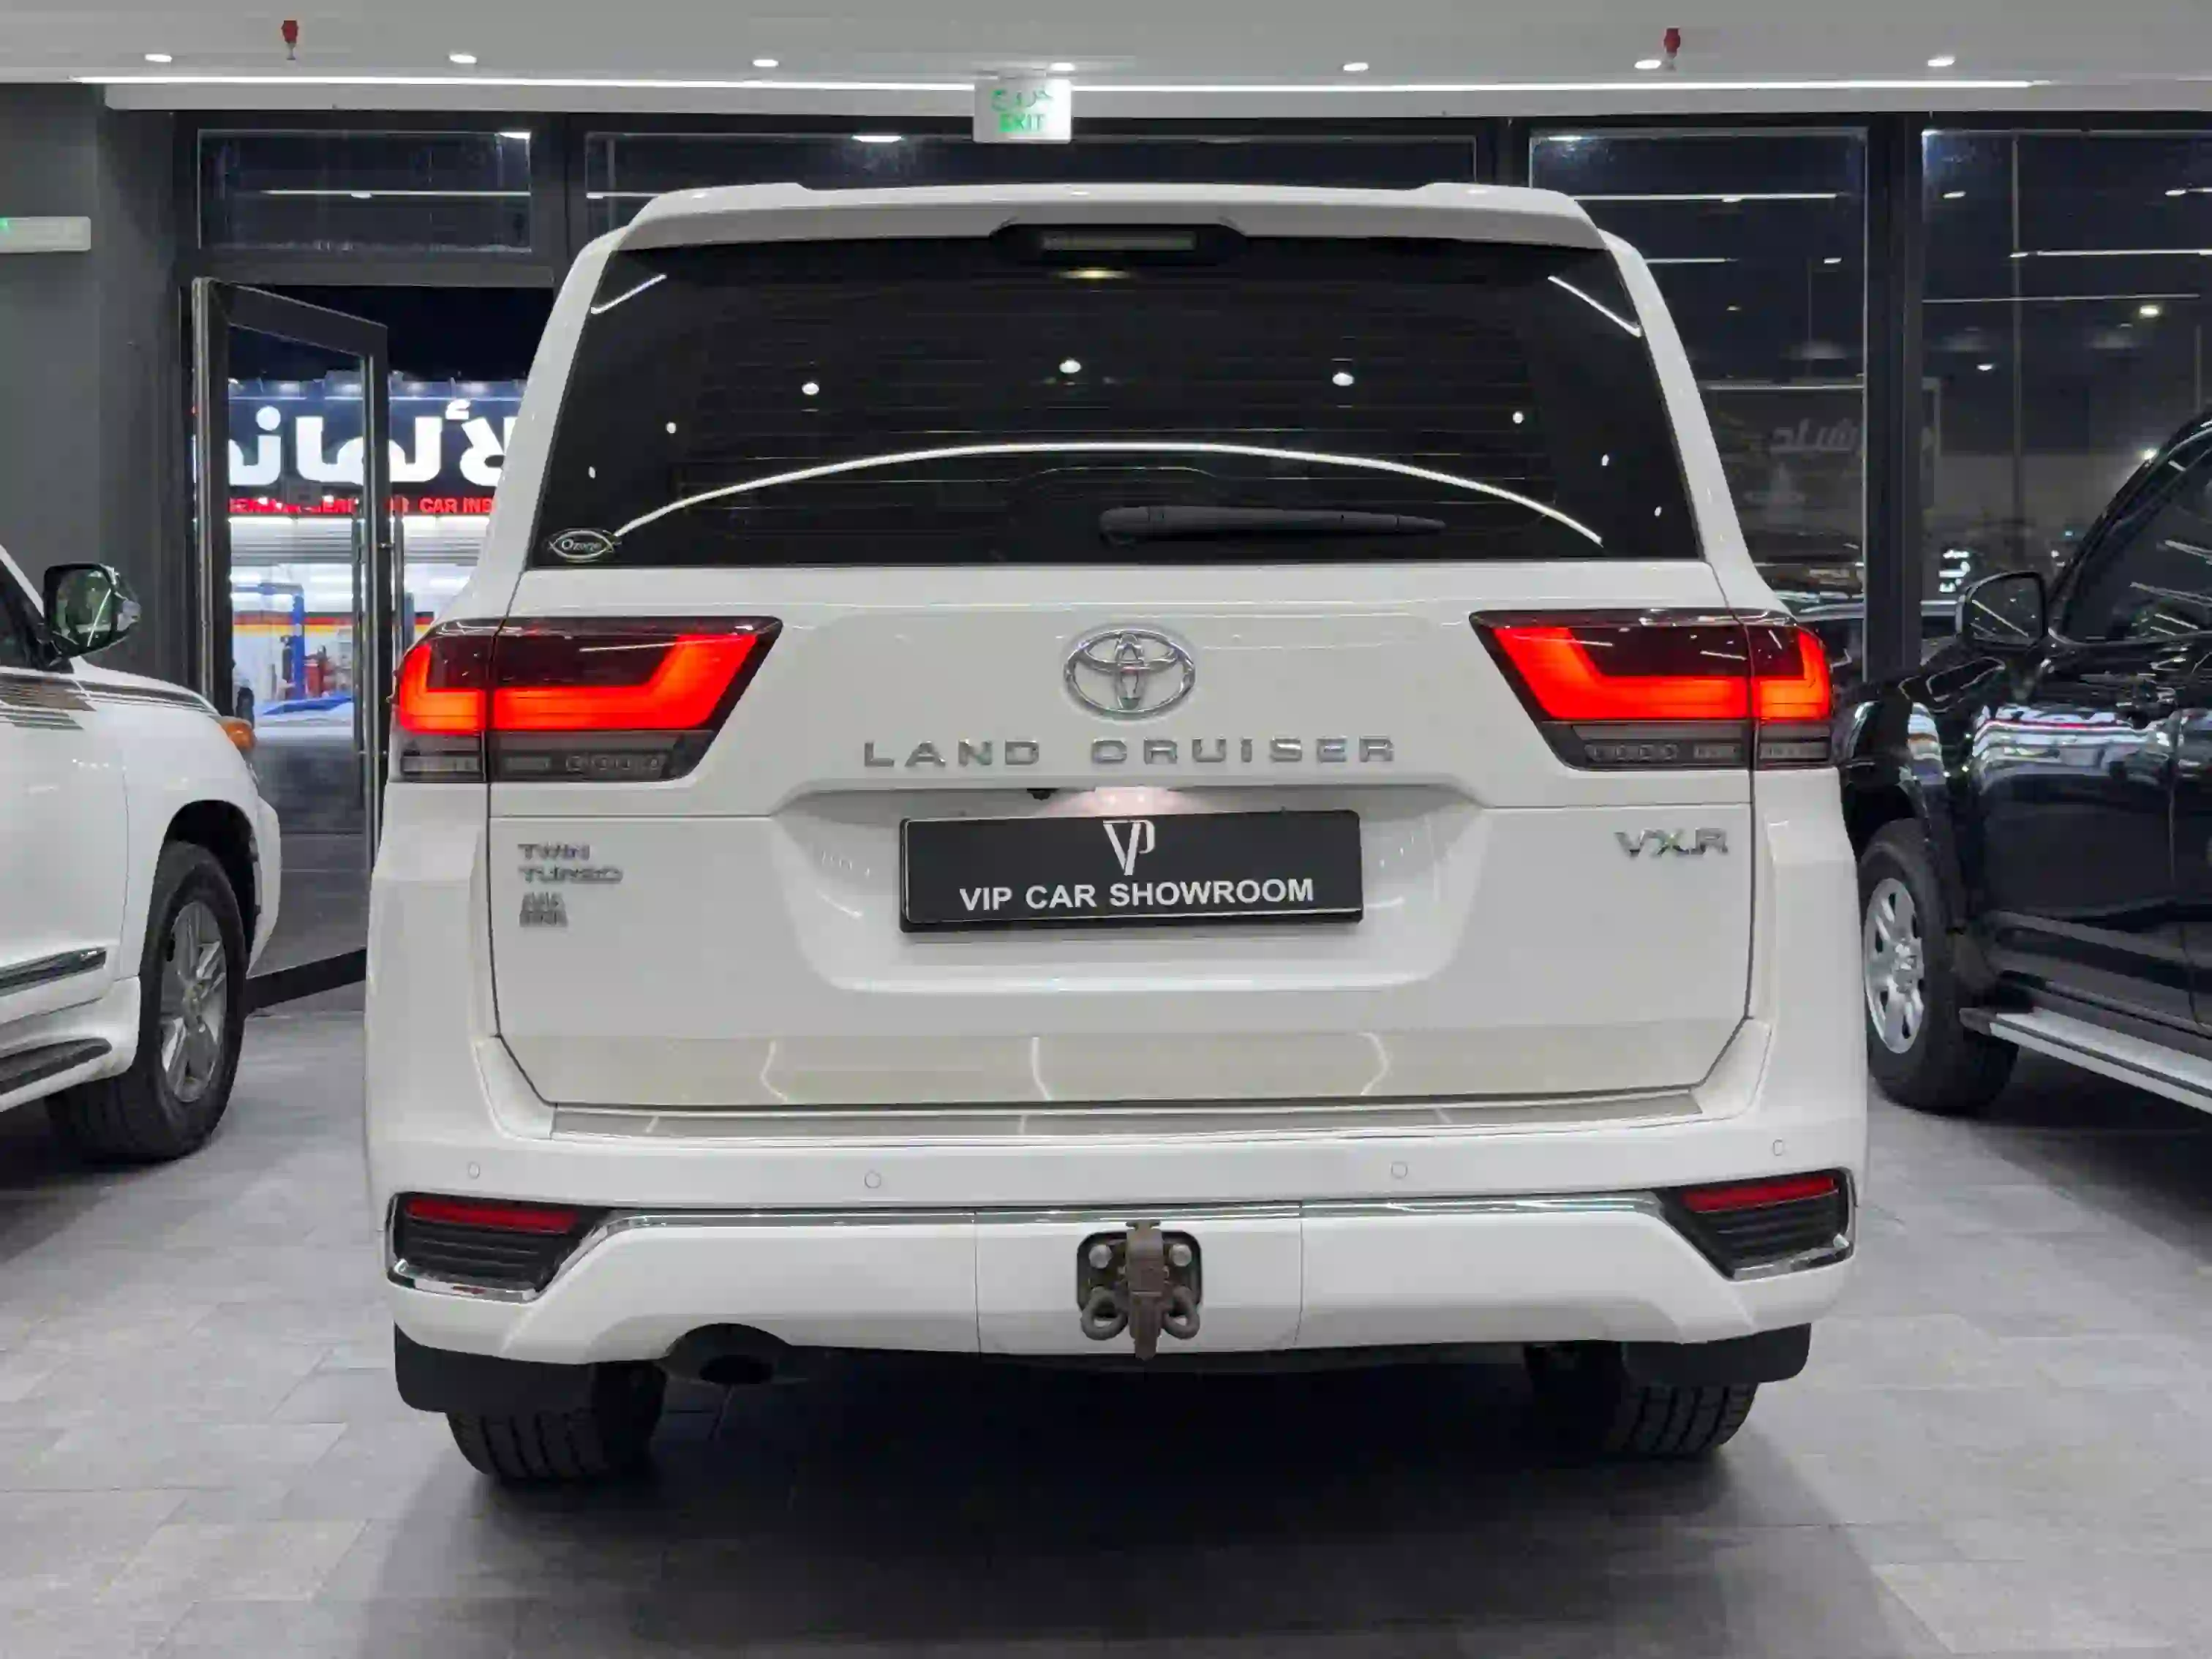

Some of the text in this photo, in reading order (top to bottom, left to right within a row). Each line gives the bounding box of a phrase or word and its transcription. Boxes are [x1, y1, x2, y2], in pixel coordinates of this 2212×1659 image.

[1000, 113, 1045, 131] EXIT
[419, 497, 457, 514] CAR
[862, 736, 1395, 767] LAND CRUISER
[517, 843, 590, 860] TWIN
[1614, 827, 1728, 859] VXR
[959, 878, 1314, 911] VIP CAR SHOWROOM
